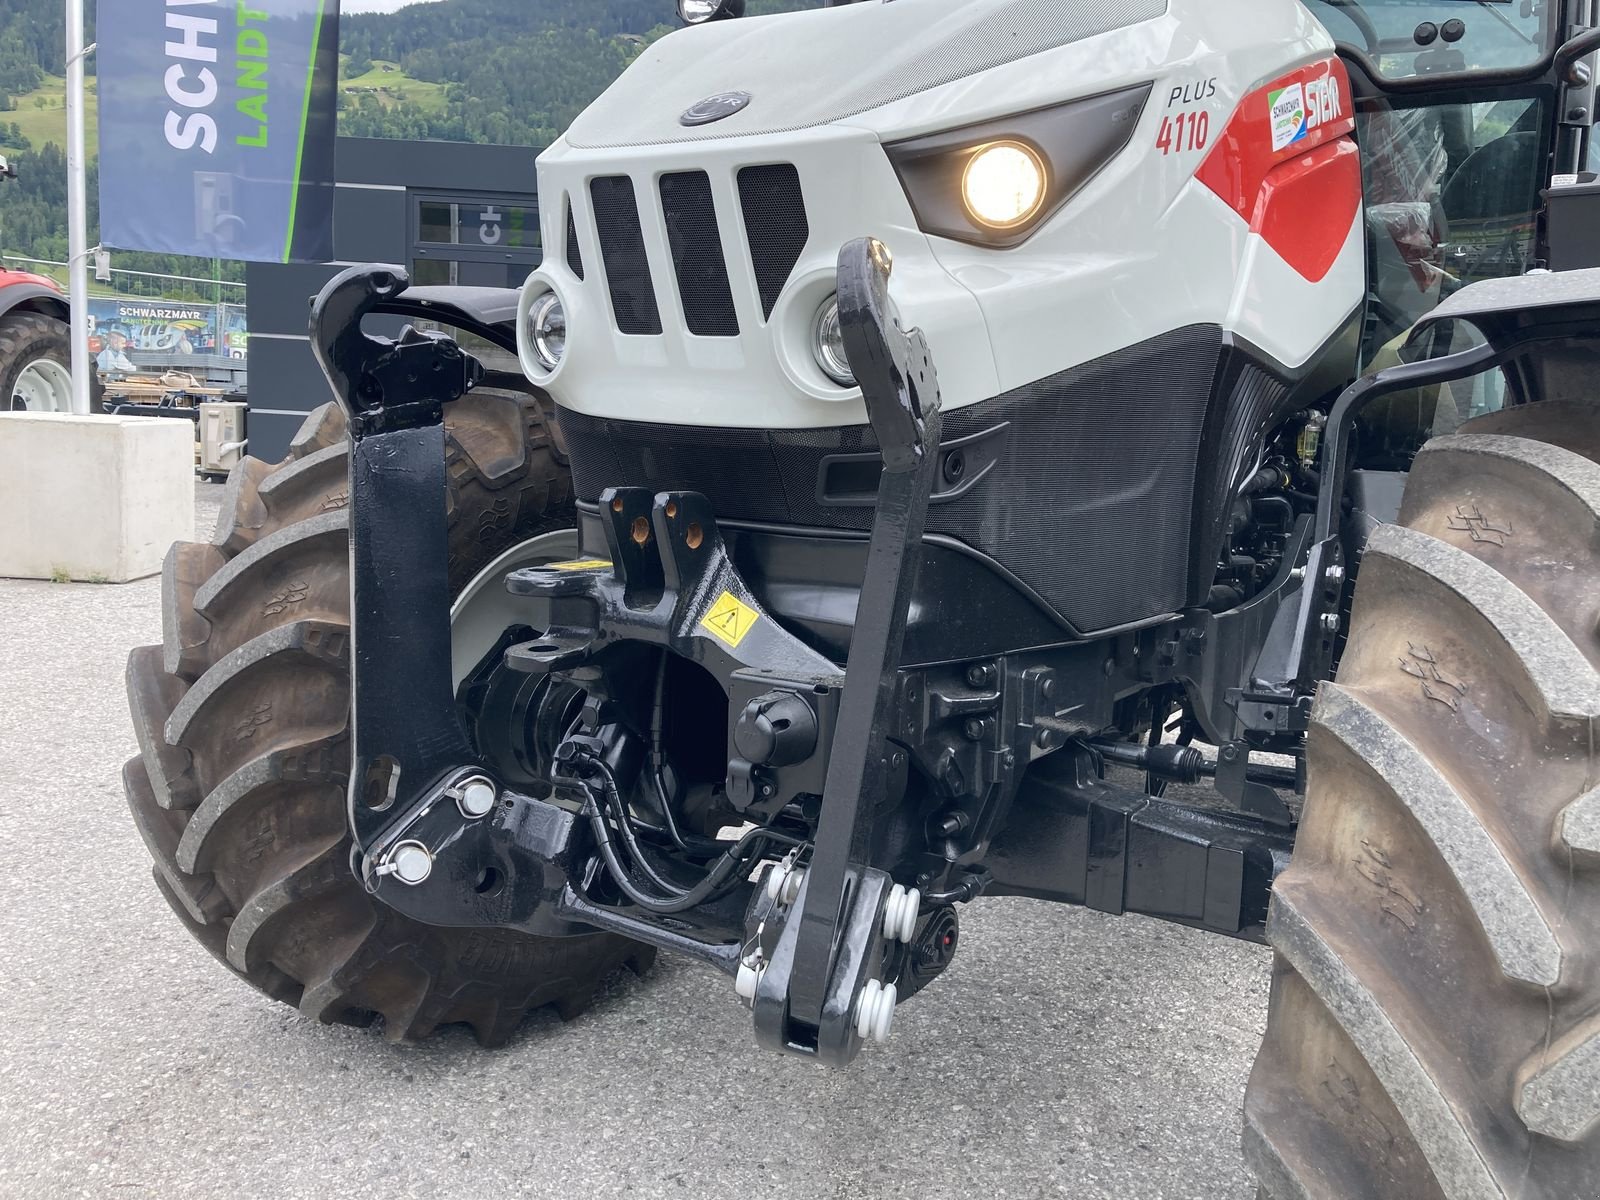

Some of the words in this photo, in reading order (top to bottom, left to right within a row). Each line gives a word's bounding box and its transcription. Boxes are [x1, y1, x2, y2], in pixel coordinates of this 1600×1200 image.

[164, 0, 218, 154] SCH
[1168, 77, 1217, 108] PLUS
[1156, 111, 1209, 155] 4110
[119, 307, 201, 319] SCHWARZMAYR
